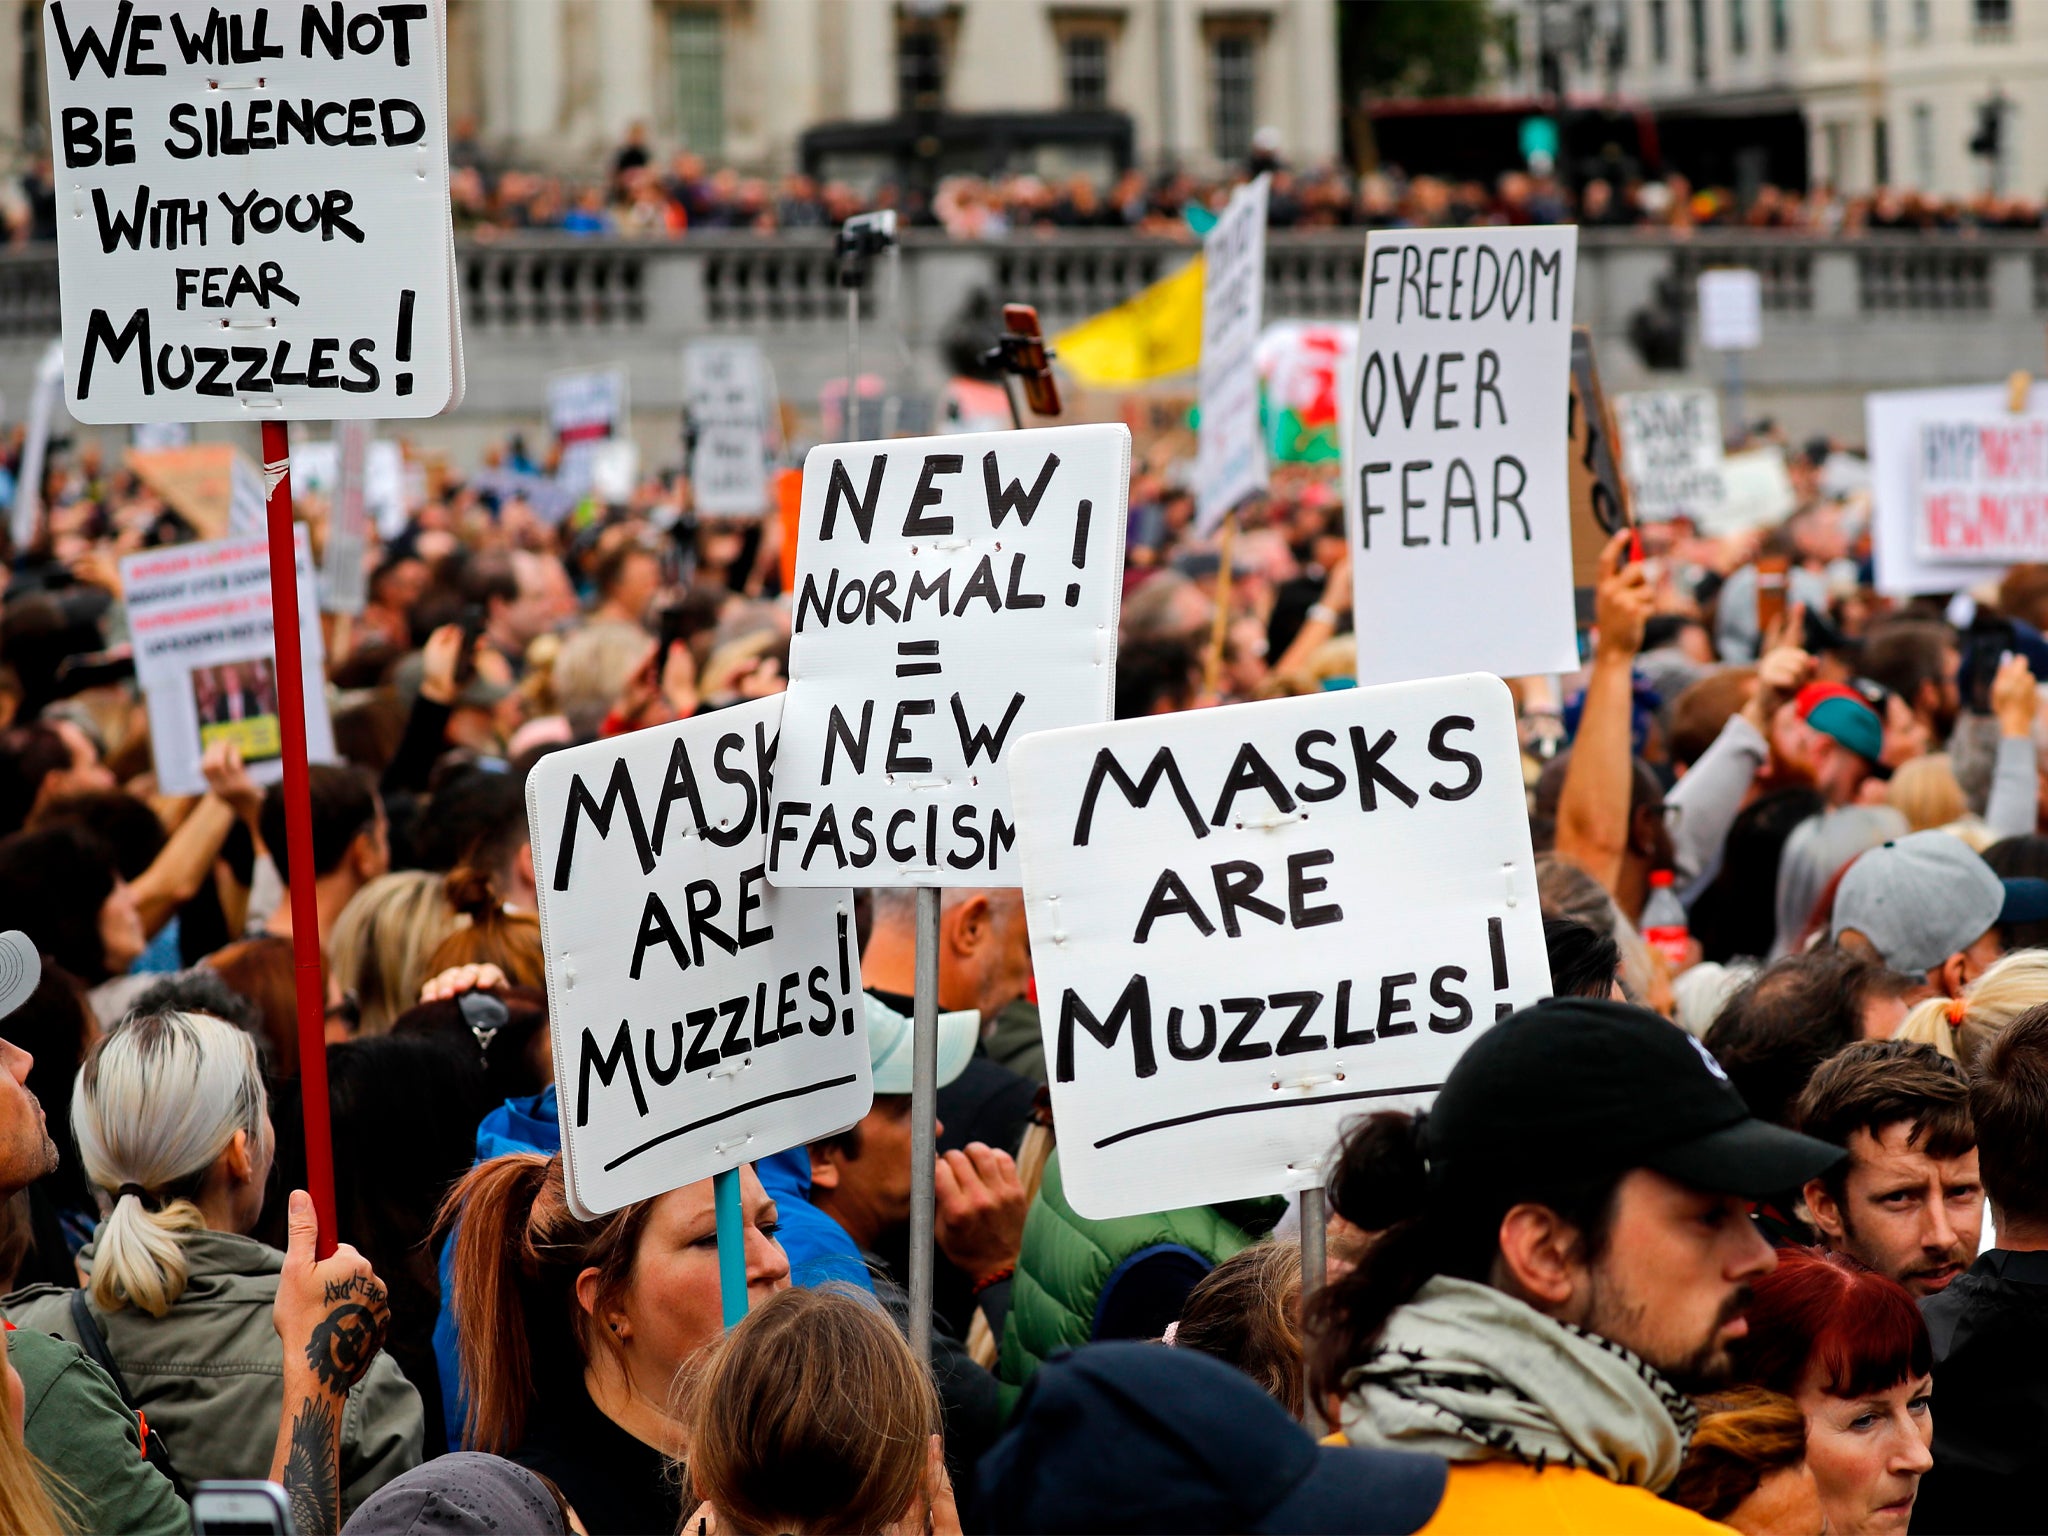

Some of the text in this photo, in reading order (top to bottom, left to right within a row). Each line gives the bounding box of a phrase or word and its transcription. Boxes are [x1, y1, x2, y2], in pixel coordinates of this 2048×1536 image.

[49, 0, 428, 82] WE WILL NOT
[61, 97, 426, 168] BE SILENCED
[91, 184, 365, 254] WITH YOUR
[175, 260, 301, 311] FEAR
[1367, 244, 1562, 323] FREEDOM
[77, 289, 416, 400] MUZZLES!
[1360, 349, 1508, 438] OVER
[818, 450, 1061, 544] NEW
[1360, 455, 1532, 549] FEAR
[820, 691, 1026, 786] NEW
[1073, 715, 1483, 847] MASKS
[629, 863, 774, 981] ARE
[1133, 848, 1344, 944] ARE
[576, 911, 855, 1128] MUZZLES!
[1056, 916, 1513, 1083] MUZZLES!
